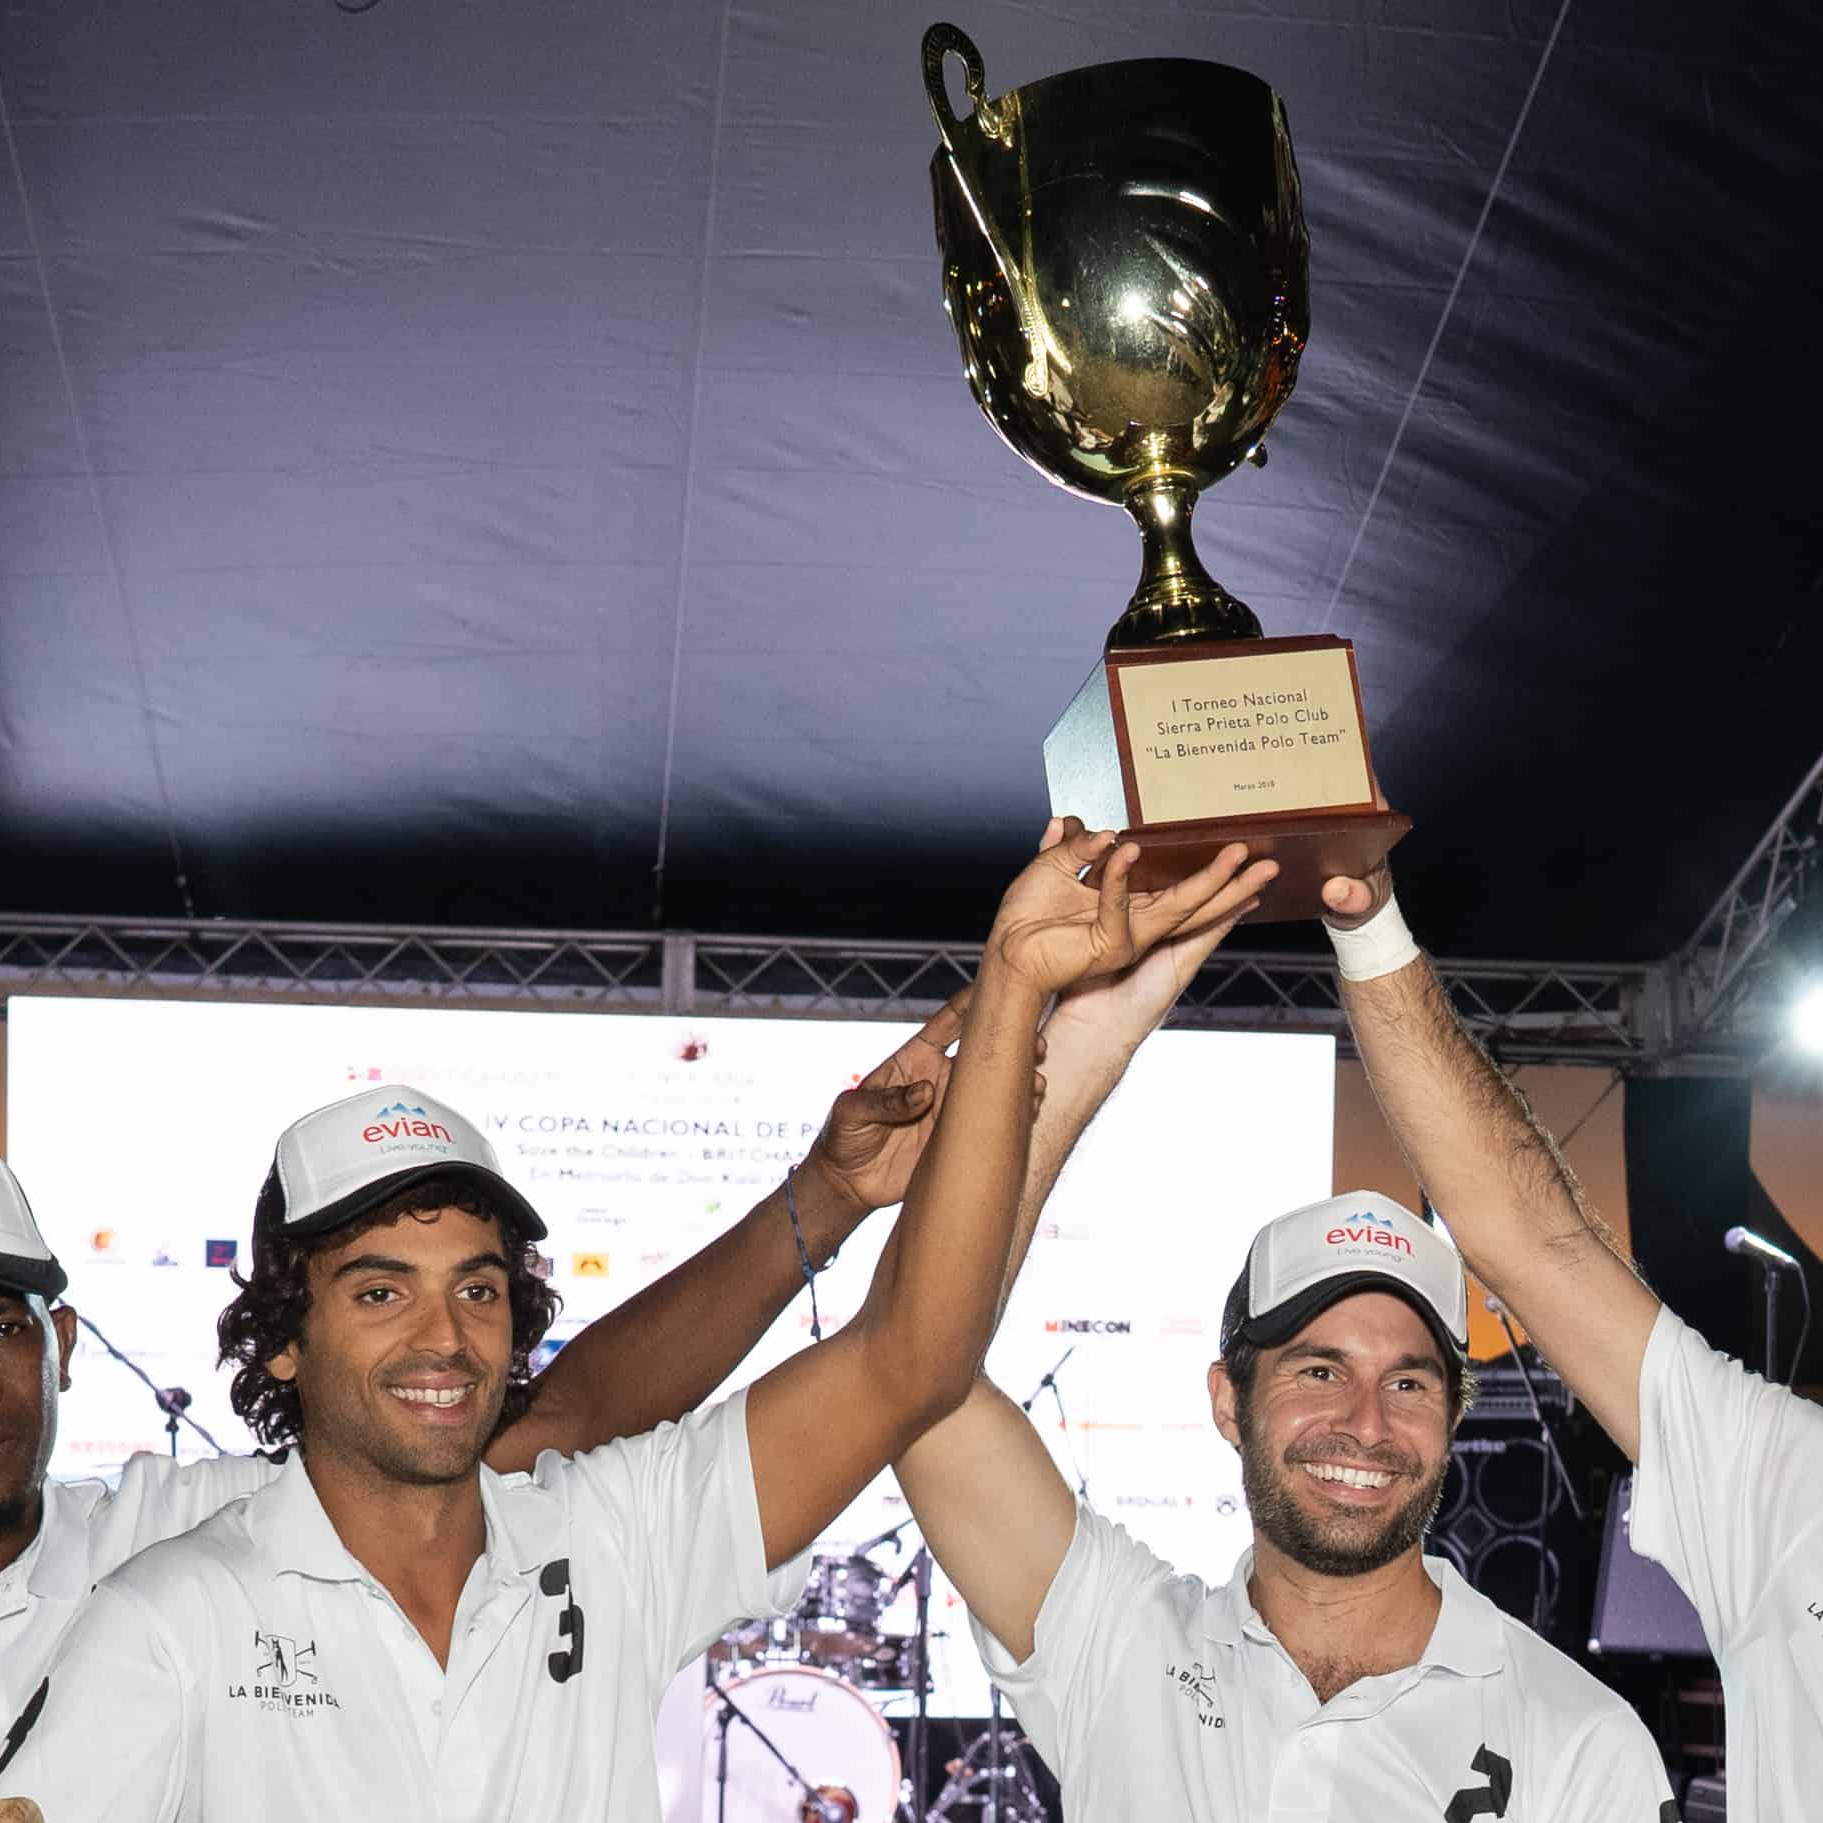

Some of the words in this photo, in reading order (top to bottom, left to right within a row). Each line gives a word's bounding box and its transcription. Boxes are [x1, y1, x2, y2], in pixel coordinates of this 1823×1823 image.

[1182, 698, 1237, 713] Torneo
[1243, 689, 1307, 707] Nacional
[1157, 722, 1201, 735] Sierra
[1207, 717, 1250, 731] Prieta
[1257, 713, 1289, 726] Polo
[1295, 709, 1328, 723] Club
[1177, 739, 1256, 758] Bienvenida
[1262, 736, 1293, 749] Polo
[519, 1115, 590, 1133] COPA
[603, 1118, 746, 1137] NACIONAL
[757, 1121, 786, 1137] DE
[540, 1558, 584, 1683] 3
[229, 1686, 247, 1698] LA
